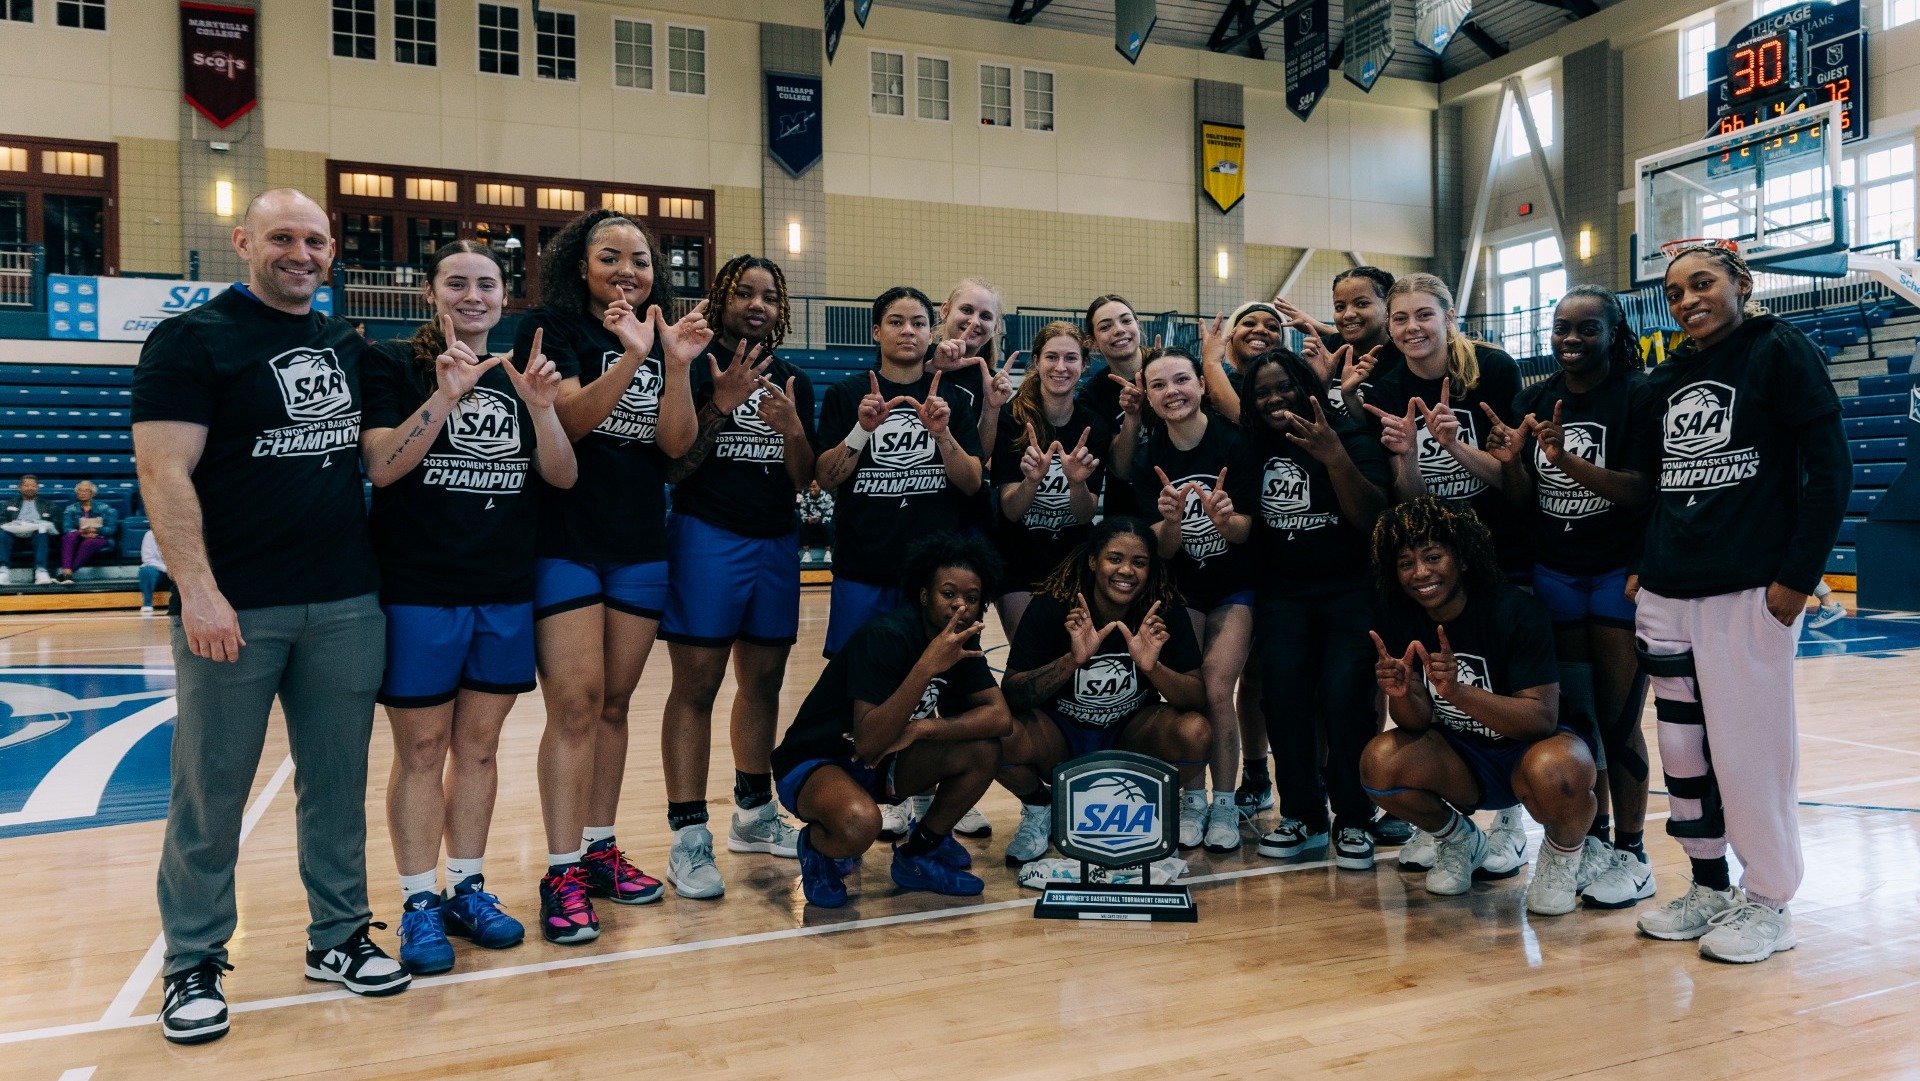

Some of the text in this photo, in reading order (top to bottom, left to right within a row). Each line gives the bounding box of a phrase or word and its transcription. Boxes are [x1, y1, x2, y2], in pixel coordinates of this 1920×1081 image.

[188, 18, 249, 32] MARYVILLE
[196, 27, 242, 39] COLLEGE
[1801, 14, 1834, 33] LIAMS
[1734, 40, 1782, 95] 30
[1817, 65, 1849, 84] GUEST
[776, 85, 814, 95] MILLSAPS
[779, 92, 812, 102] COLLEGE
[1824, 78, 1851, 101] 72
[162, 286, 211, 310] SA
[293, 371, 344, 405] SAA
[628, 376, 659, 396] AA
[611, 410, 636, 421] MEN'S
[1671, 409, 1725, 438] SAA
[457, 412, 514, 439] SAA
[597, 417, 656, 439] AMPIO
[252, 425, 360, 457] CHAMPION
[735, 436, 768, 444] WOMEN'S
[878, 430, 928, 452] SAA
[716, 443, 784, 459] CHAMPI
[1696, 451, 1761, 467] BASKETBALL
[423, 458, 528, 471] 2026 WOMEN'S BASKET
[423, 468, 526, 489] CHAMPIO
[872, 470, 909, 479] WOMEN'S
[1425, 475, 1454, 484] OMEN'S
[1263, 479, 1305, 500] SAA
[1539, 495, 1613, 514] HAMPION
[1081, 674, 1131, 696] SAA
[1075, 706, 1111, 714] WOMEN'S
[1077, 803, 1154, 833] SAA
[1090, 895, 1120, 903] BASKETBALL
